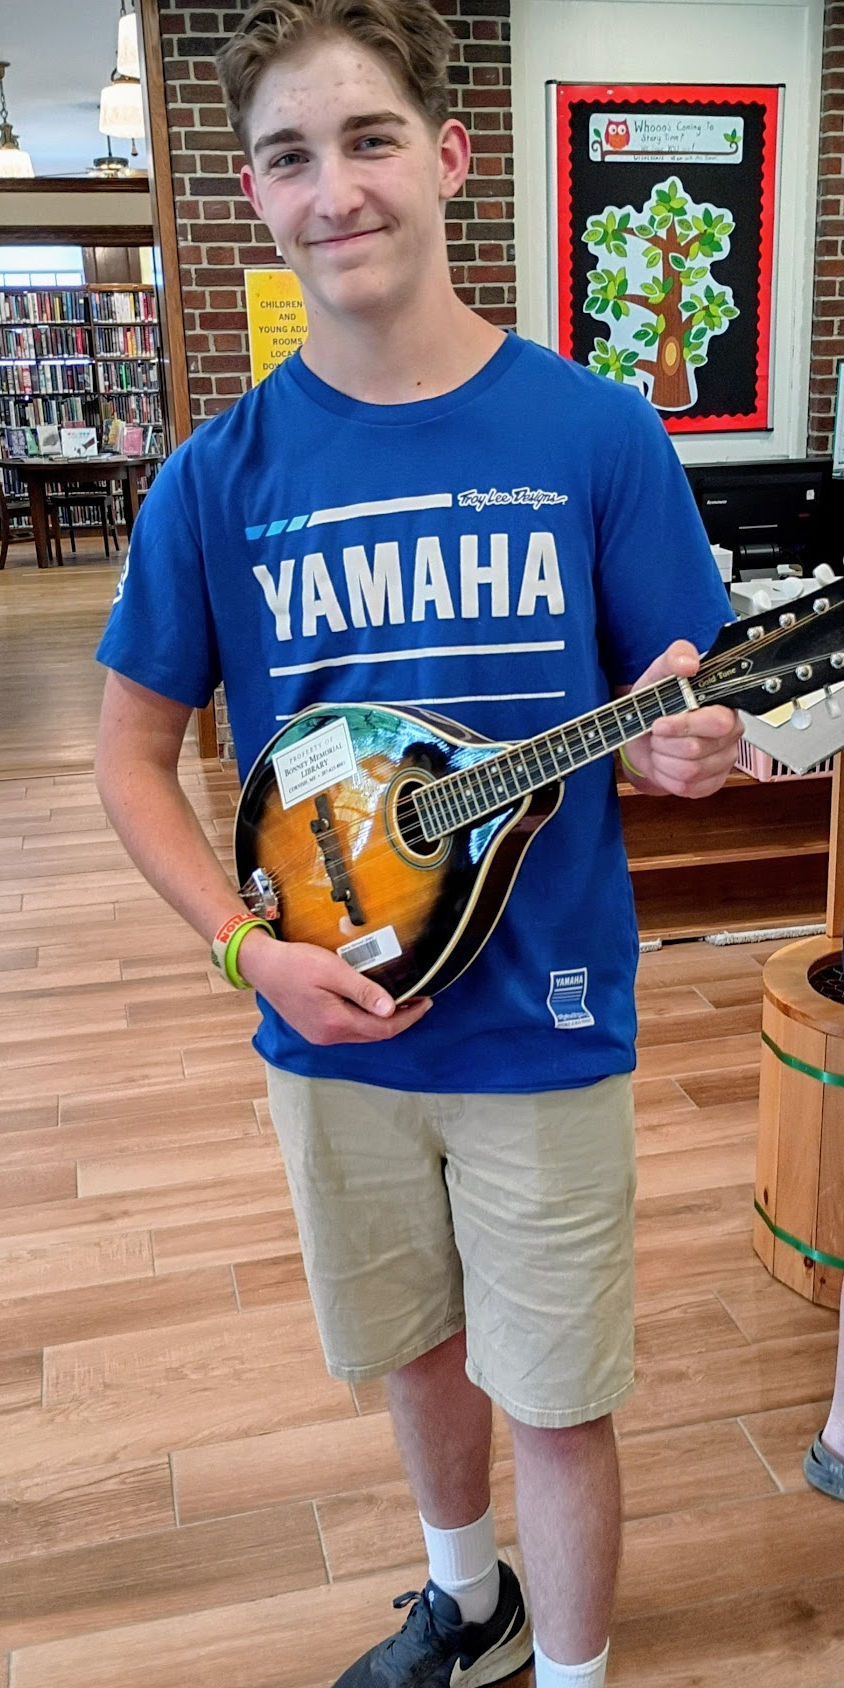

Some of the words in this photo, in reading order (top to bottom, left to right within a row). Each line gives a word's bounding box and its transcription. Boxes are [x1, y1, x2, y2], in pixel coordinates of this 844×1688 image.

[641, 133, 661, 145] Story
[260, 301, 303, 309] CHILDREN
[278, 313, 296, 321] AND
[457, 488, 487, 512] Troy
[486, 488, 512, 506] Lee
[511, 486, 568, 510] Designs
[252, 532, 565, 641] YAMAHA
[698, 675, 716, 687] Gold
[717, 668, 736, 679] Tone
[300, 759, 329, 778] LIBRARY
[555, 975, 583, 987] YAMAHA
